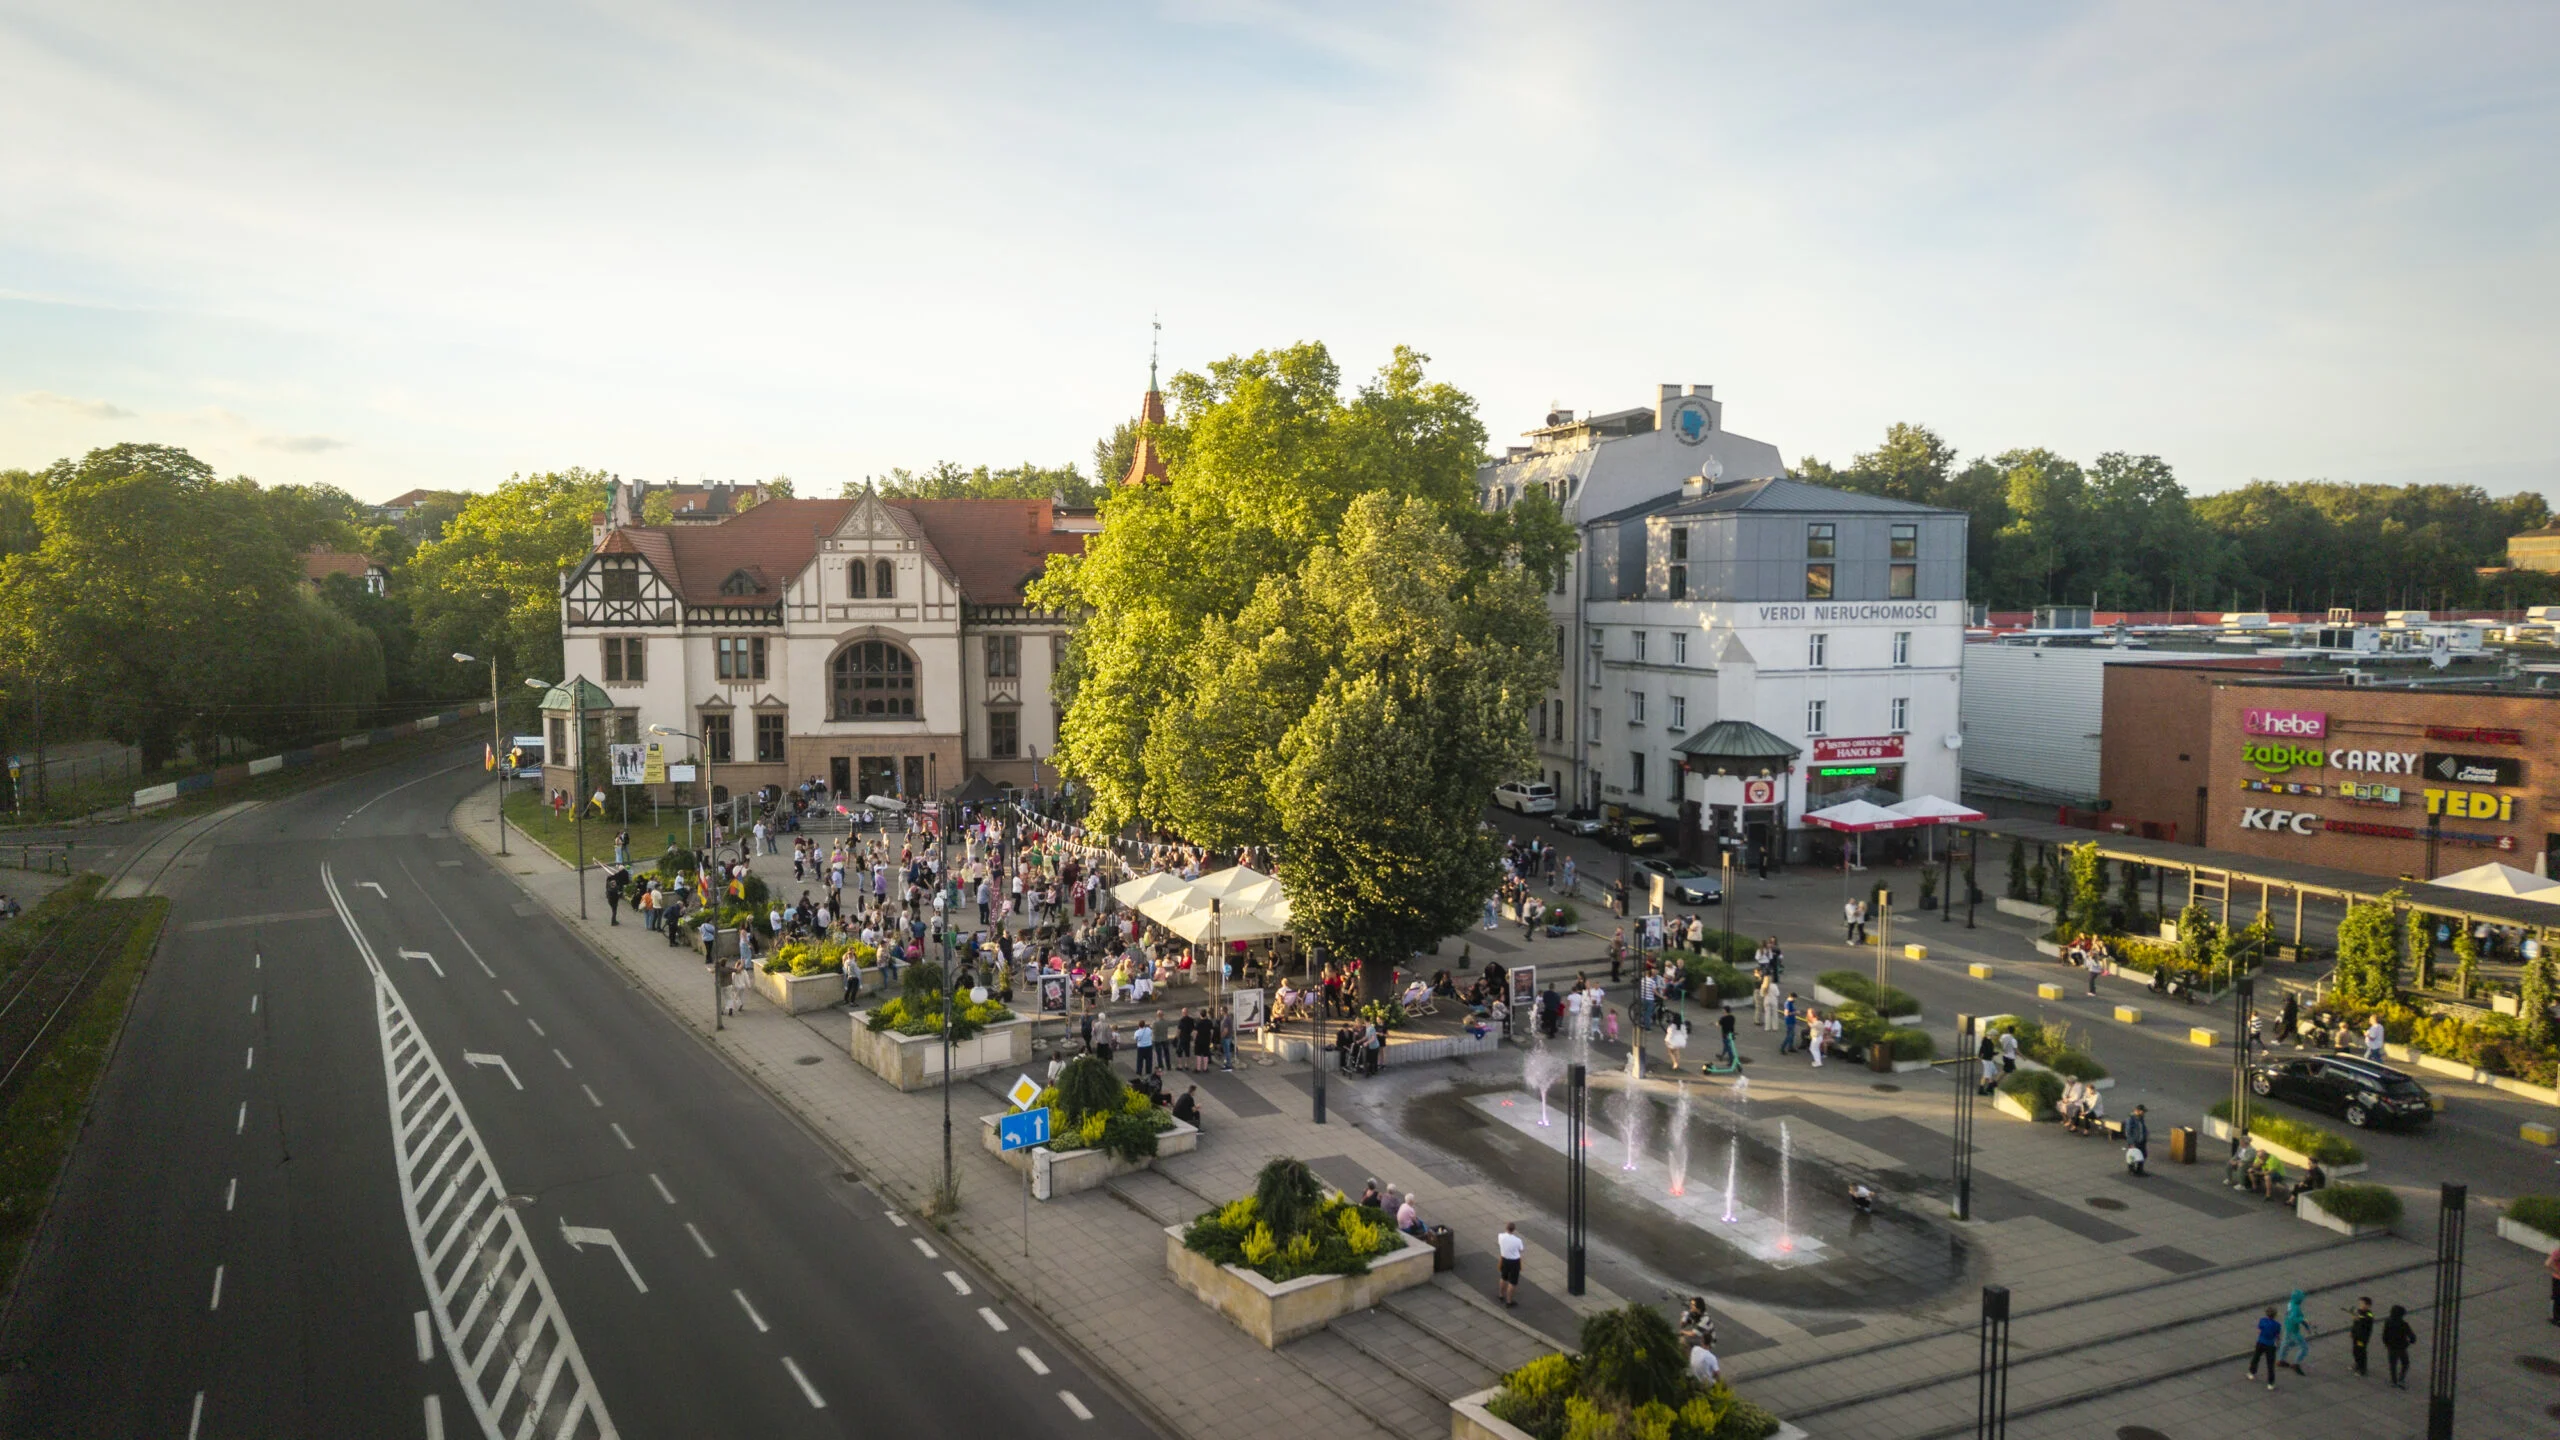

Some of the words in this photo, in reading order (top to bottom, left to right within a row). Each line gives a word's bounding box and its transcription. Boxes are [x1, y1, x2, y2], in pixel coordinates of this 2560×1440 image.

[1760, 606, 1805, 620] VERDI
[1815, 603, 1937, 620] NIERUCHOMOŚCI
[2265, 712, 2320, 735] hebe
[1837, 747, 1868, 757] HANOI
[1869, 747, 1882, 756] 68
[2242, 741, 2324, 767] żabka
[2330, 748, 2418, 775] CARRY
[2423, 788, 2513, 822] TEDi
[2240, 807, 2317, 835] KFC
